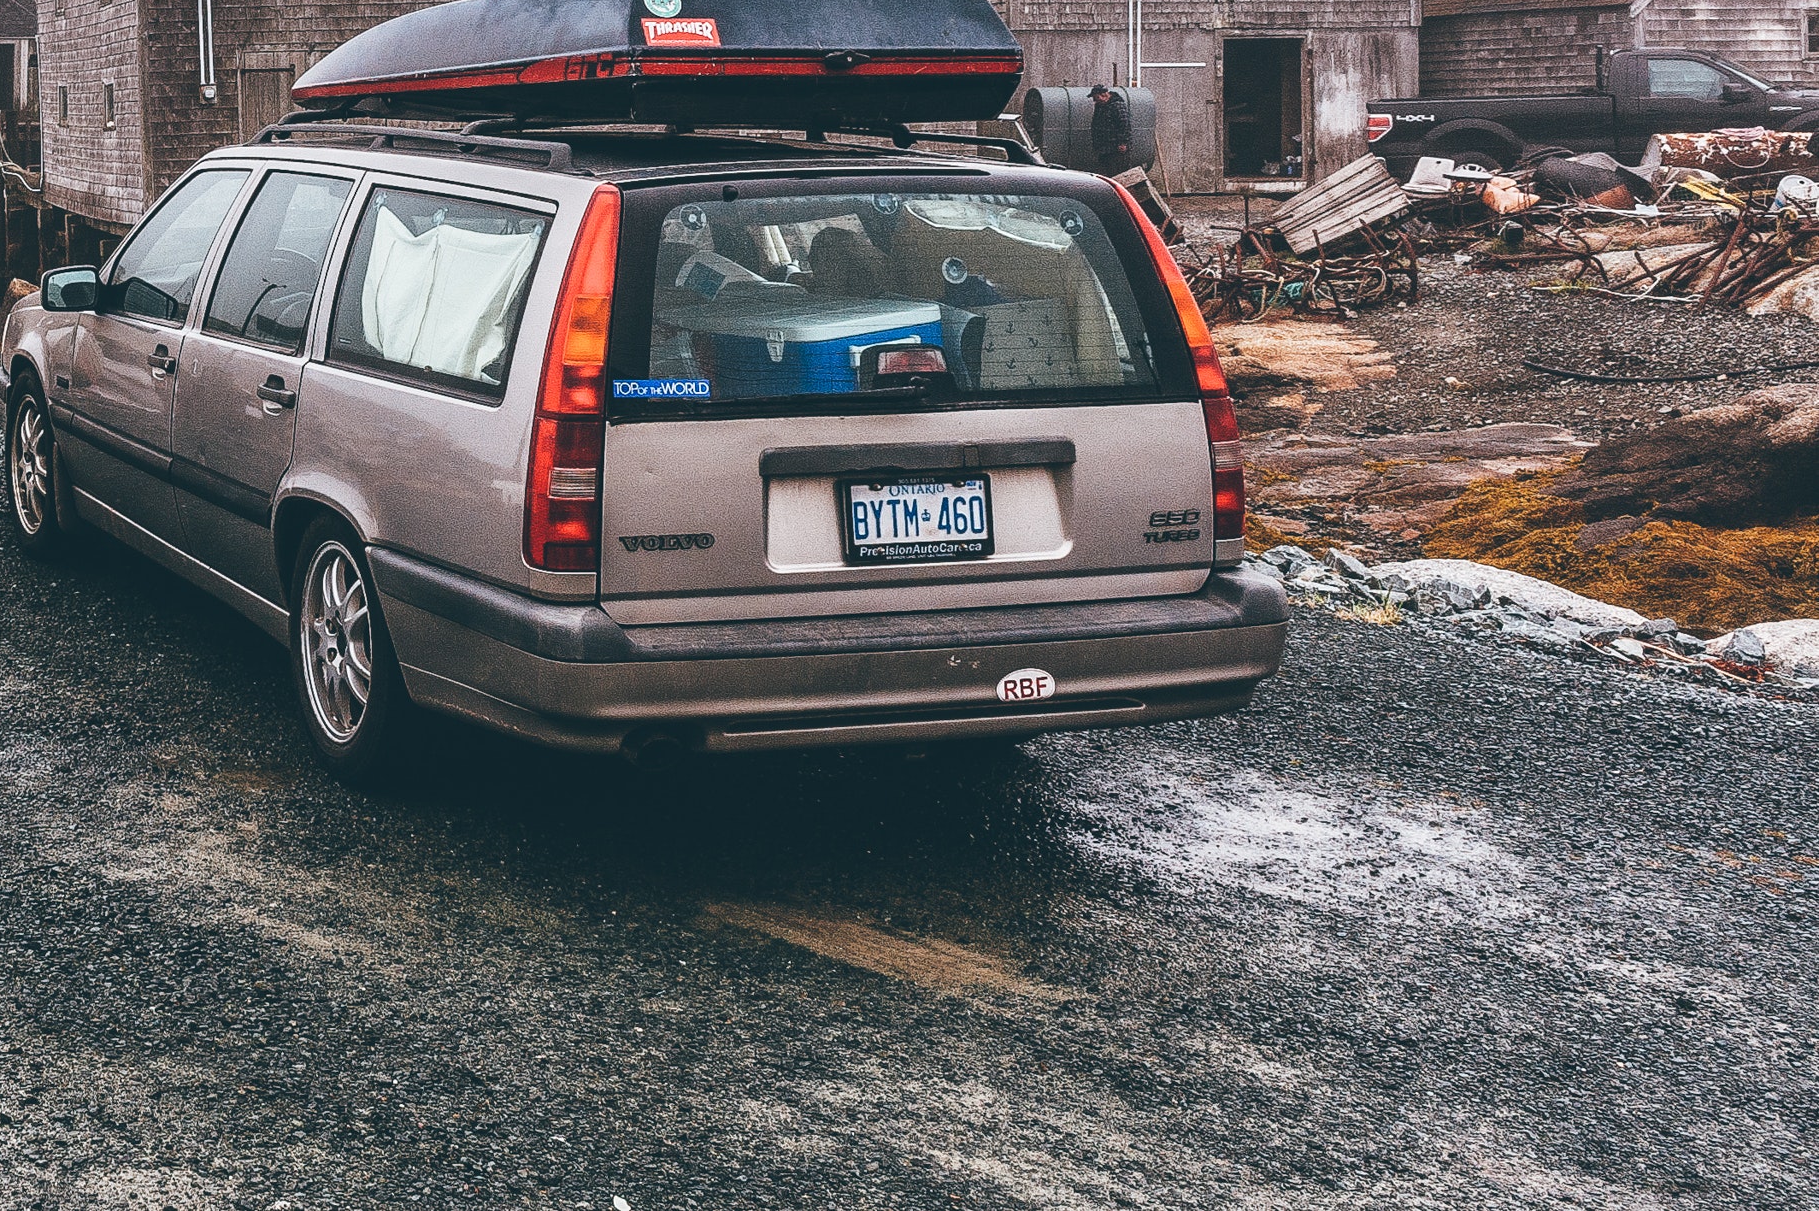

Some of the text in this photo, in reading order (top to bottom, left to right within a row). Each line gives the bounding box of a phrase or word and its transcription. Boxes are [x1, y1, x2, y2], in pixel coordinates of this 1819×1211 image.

[645, 21, 714, 40] THRASHER
[661, 382, 710, 395] WORLD
[853, 496, 985, 540] BYTM 460
[619, 533, 715, 552] VOLVO
[1143, 529, 1200, 543] TURBO
[1004, 676, 1048, 700] RBF
